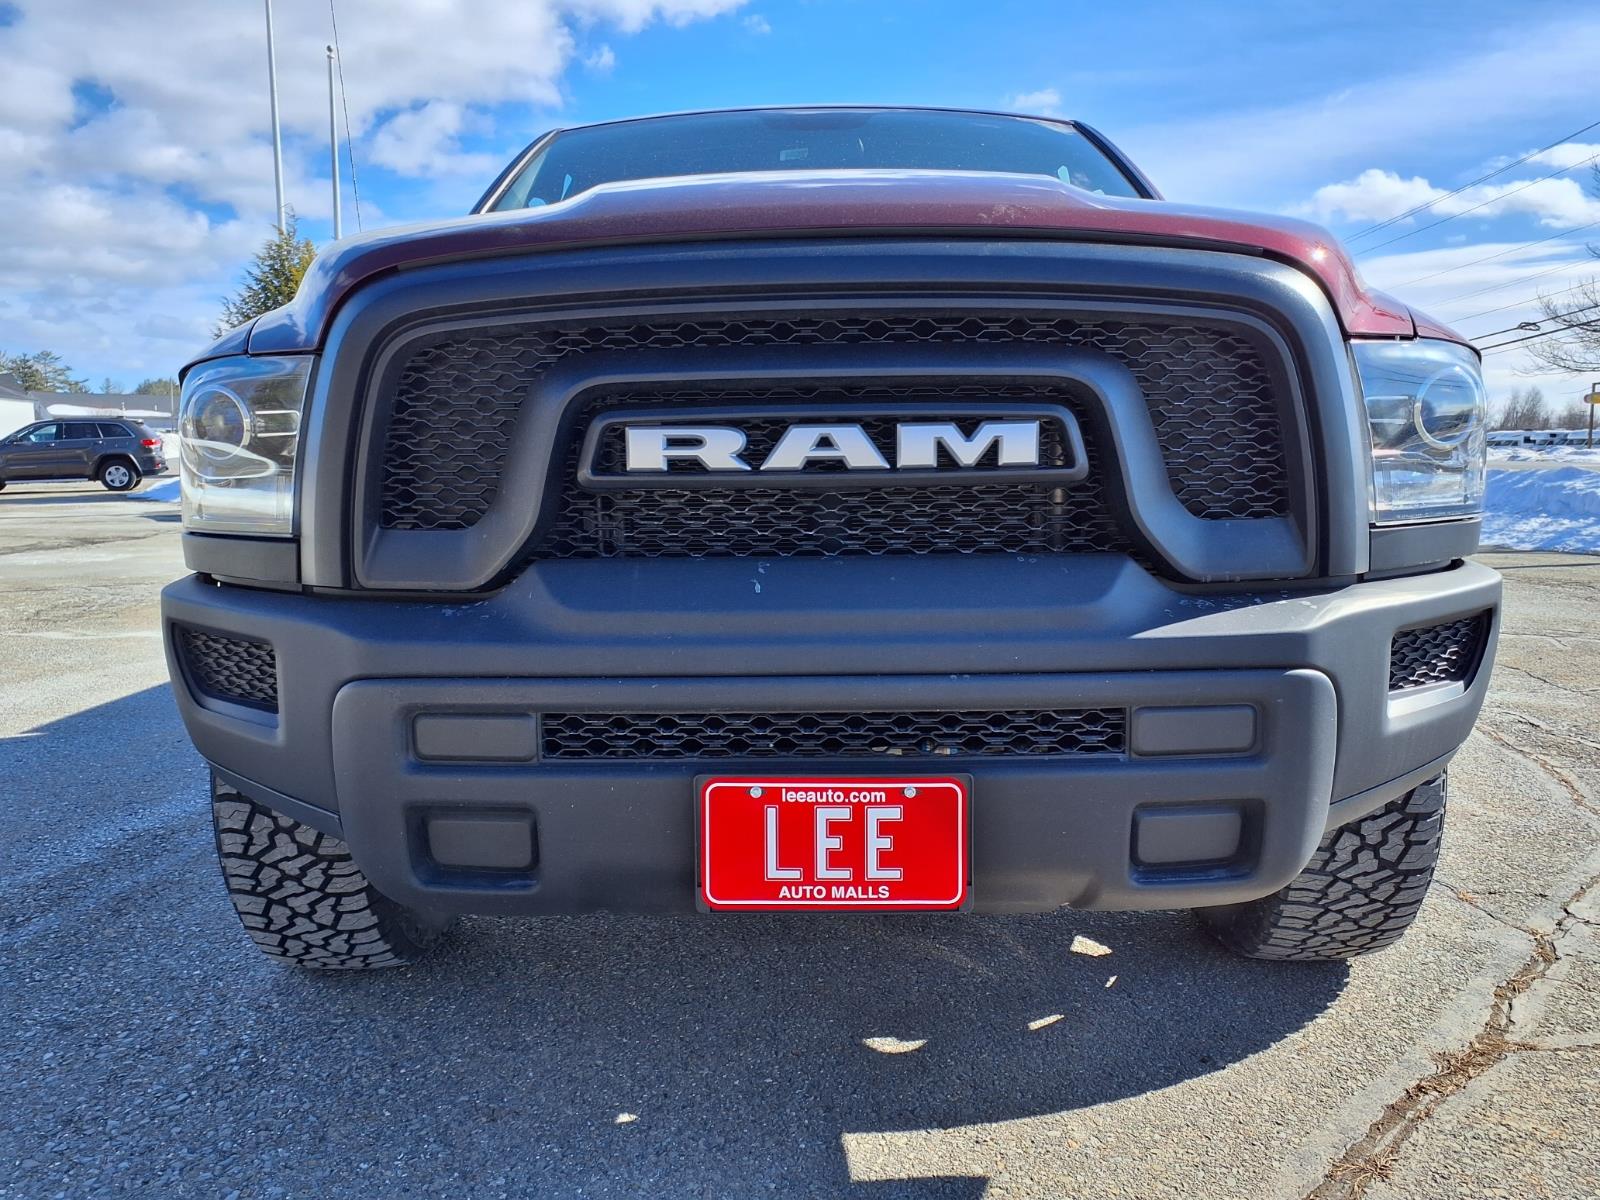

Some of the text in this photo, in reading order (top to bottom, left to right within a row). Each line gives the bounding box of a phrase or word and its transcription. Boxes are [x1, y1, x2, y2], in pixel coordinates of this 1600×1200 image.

[625, 420, 1041, 472] RAM
[781, 788, 886, 803] leeauto.com
[764, 805, 904, 881] LEE
[778, 886, 890, 899] AUTO MALLS
